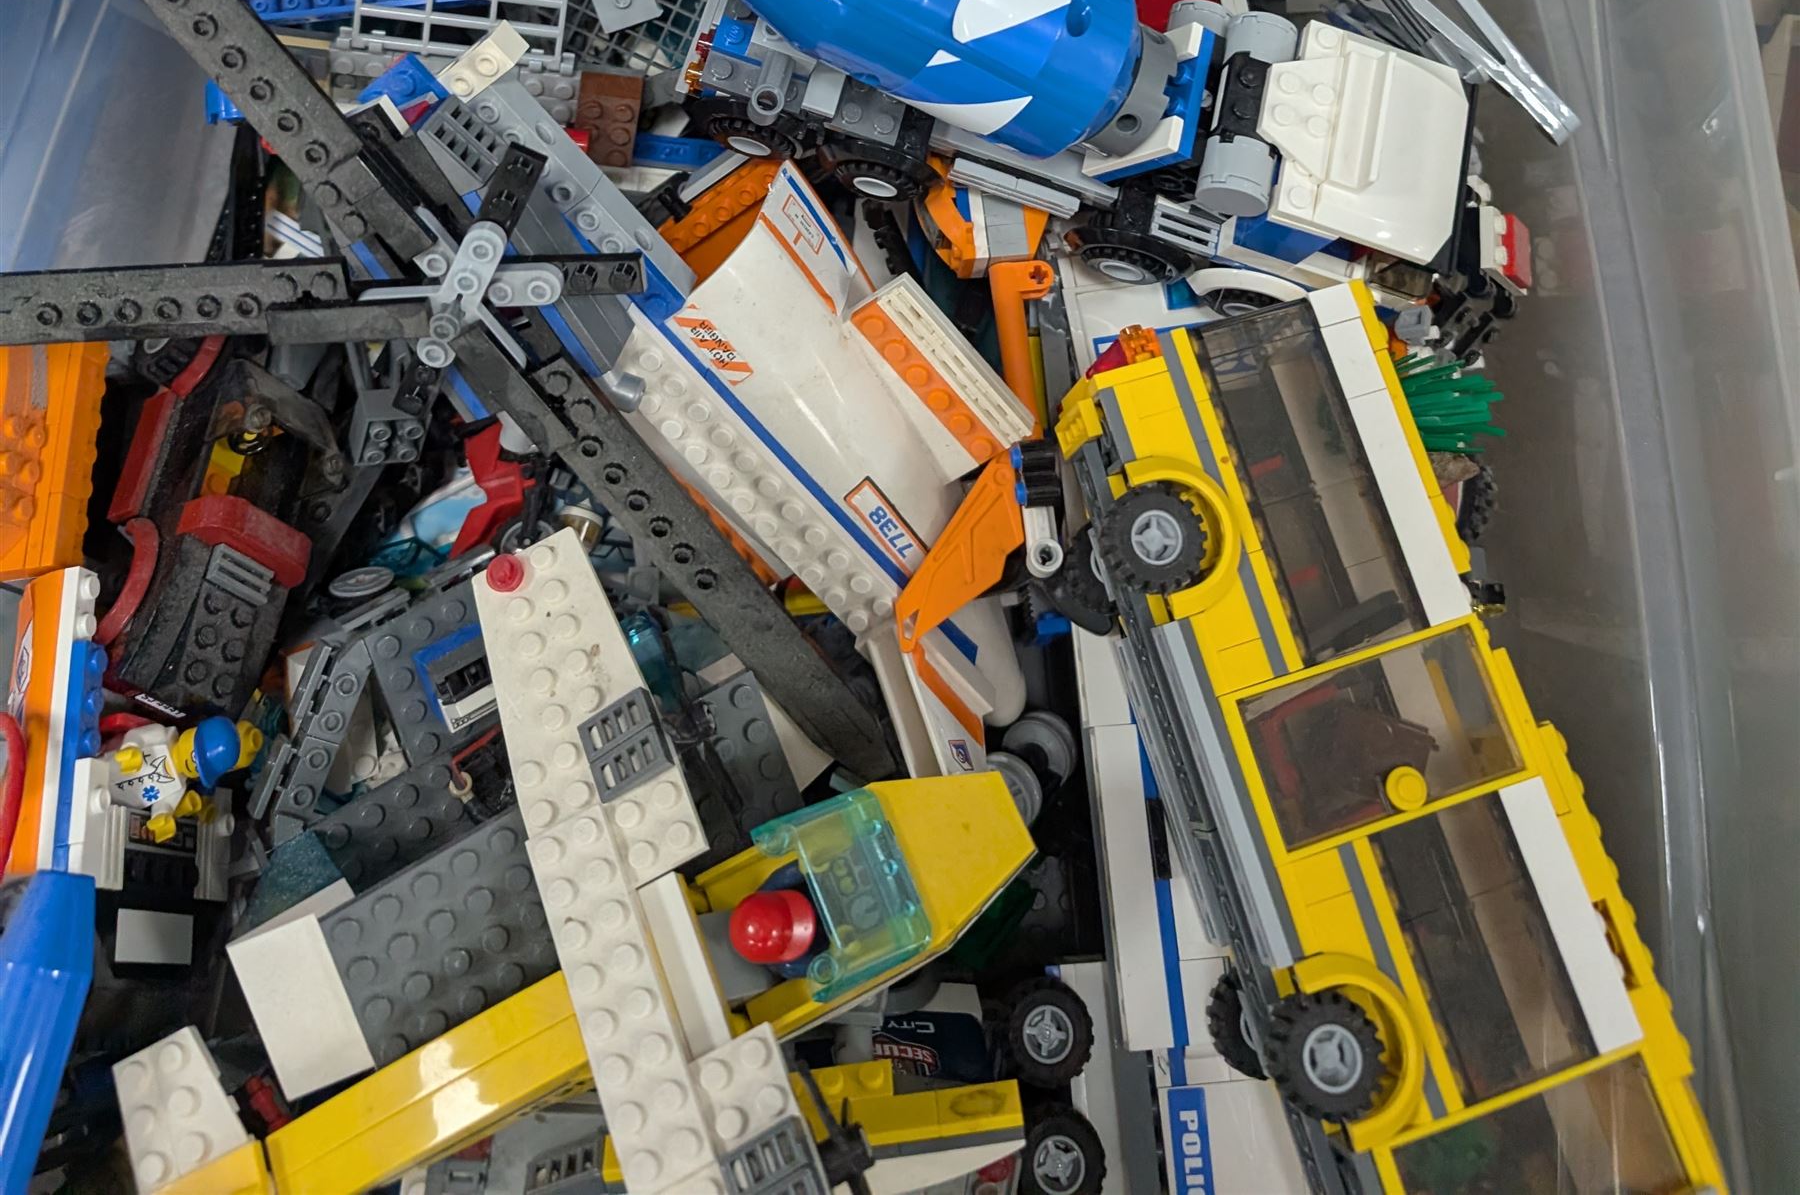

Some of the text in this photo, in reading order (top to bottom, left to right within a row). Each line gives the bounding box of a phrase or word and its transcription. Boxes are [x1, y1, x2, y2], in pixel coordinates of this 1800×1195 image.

[690, 326, 729, 367] HOT AIR
[698, 320, 737, 361] DANGER
[868, 505, 913, 558] 7738
